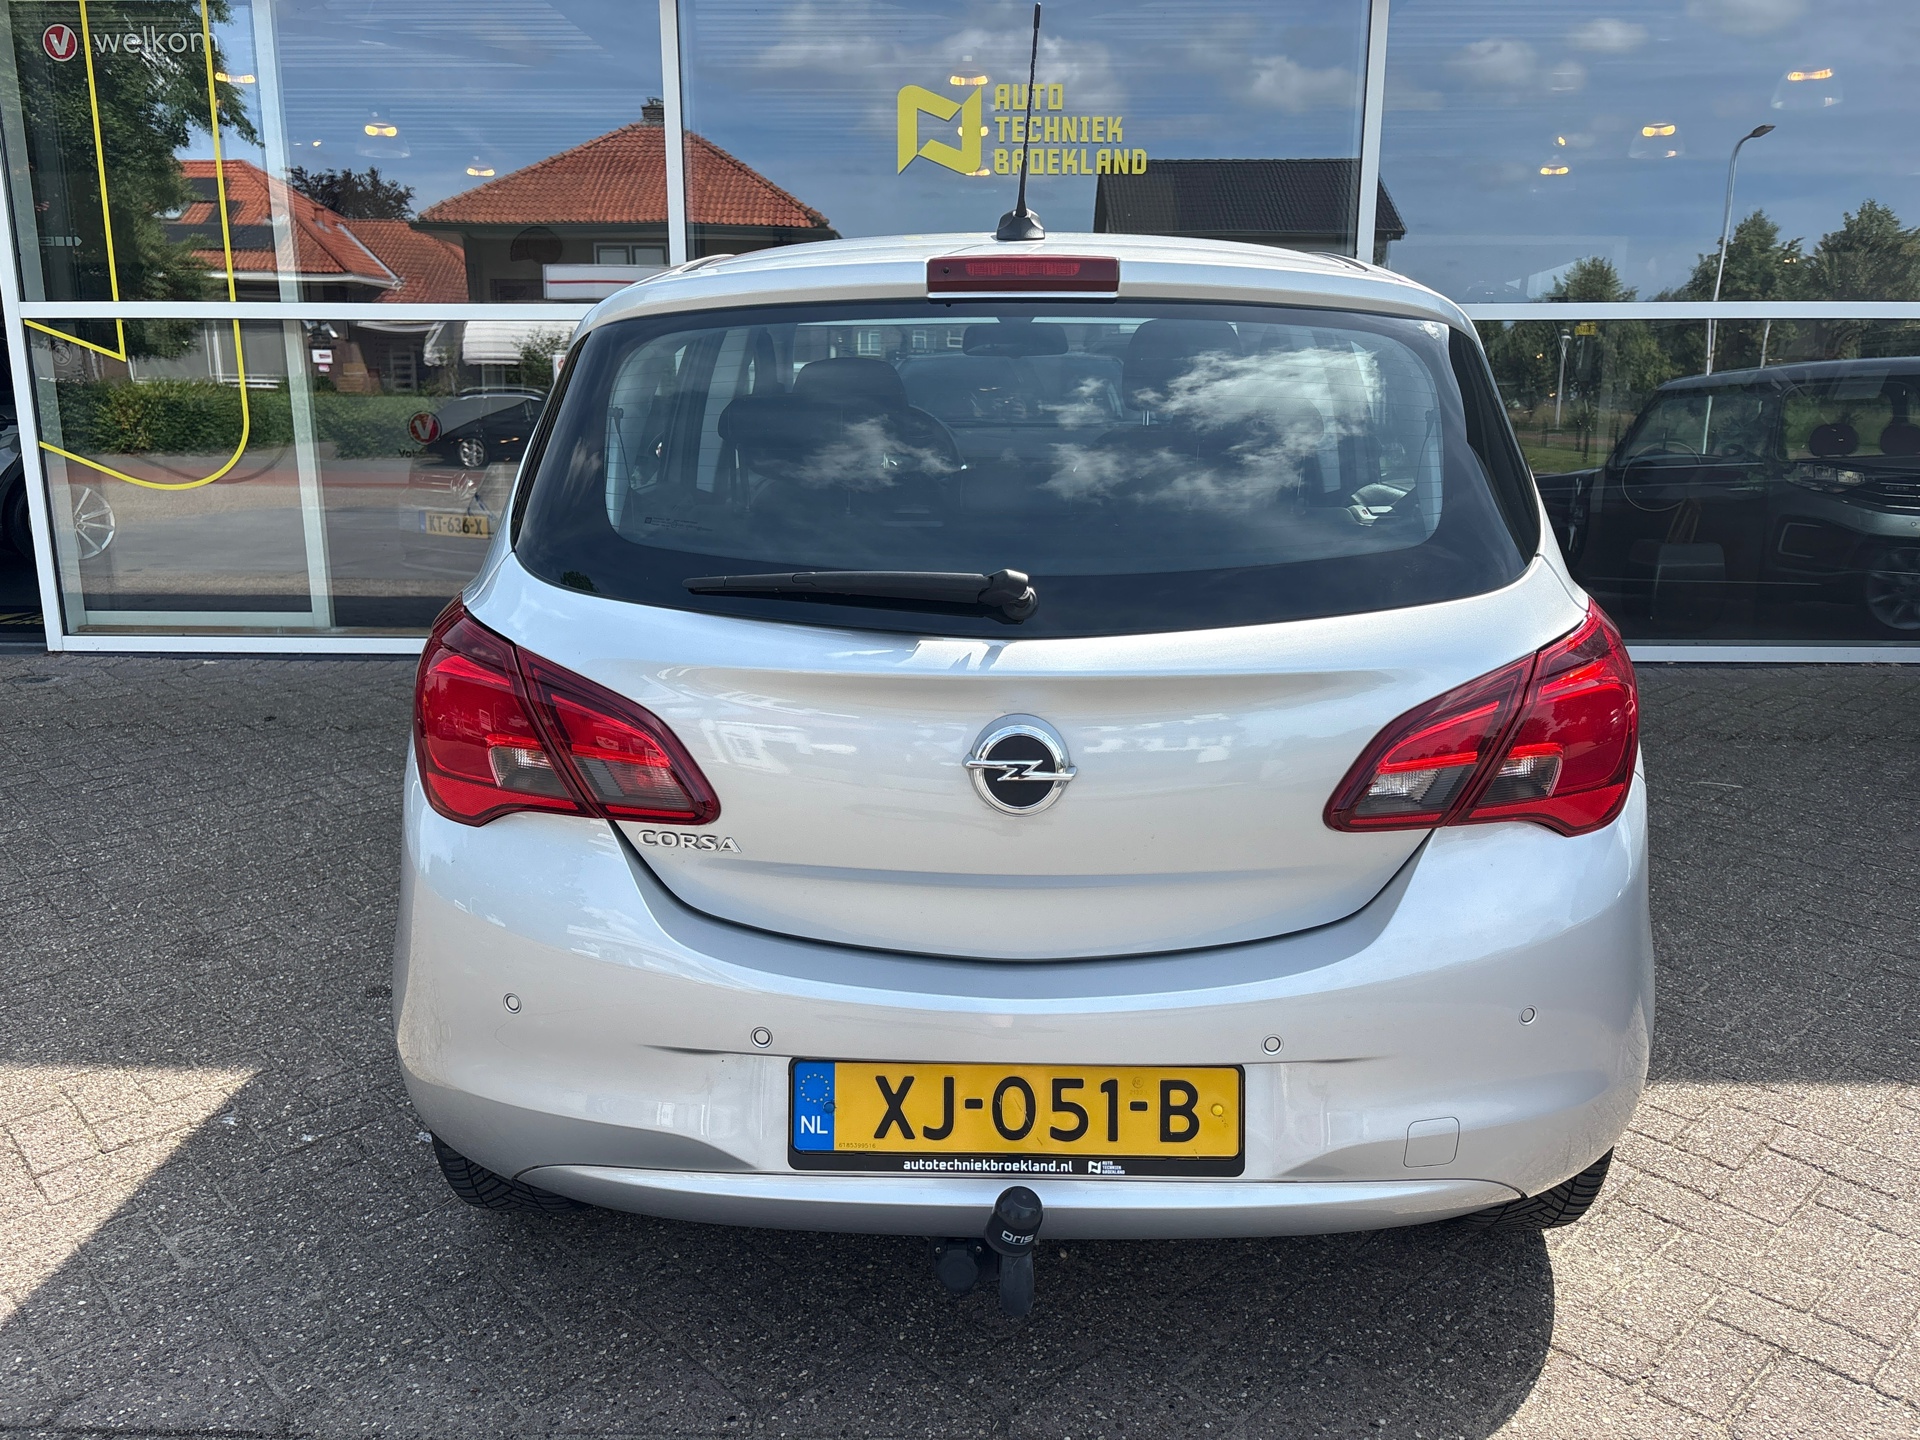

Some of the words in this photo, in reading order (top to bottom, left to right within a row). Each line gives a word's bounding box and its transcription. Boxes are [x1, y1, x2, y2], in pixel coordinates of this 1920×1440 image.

[93, 25, 219, 54] welkom
[994, 83, 1064, 110] AUTO
[994, 116, 1123, 143] TECHNIEK
[993, 148, 1148, 175] BROEKLAND
[428, 514, 484, 536] KT-636-X
[637, 829, 742, 853] CORSA
[800, 1115, 829, 1135] NL
[873, 1074, 1201, 1143] XJ-051-B
[902, 1158, 1073, 1173] autotechniekbroekland.nl
